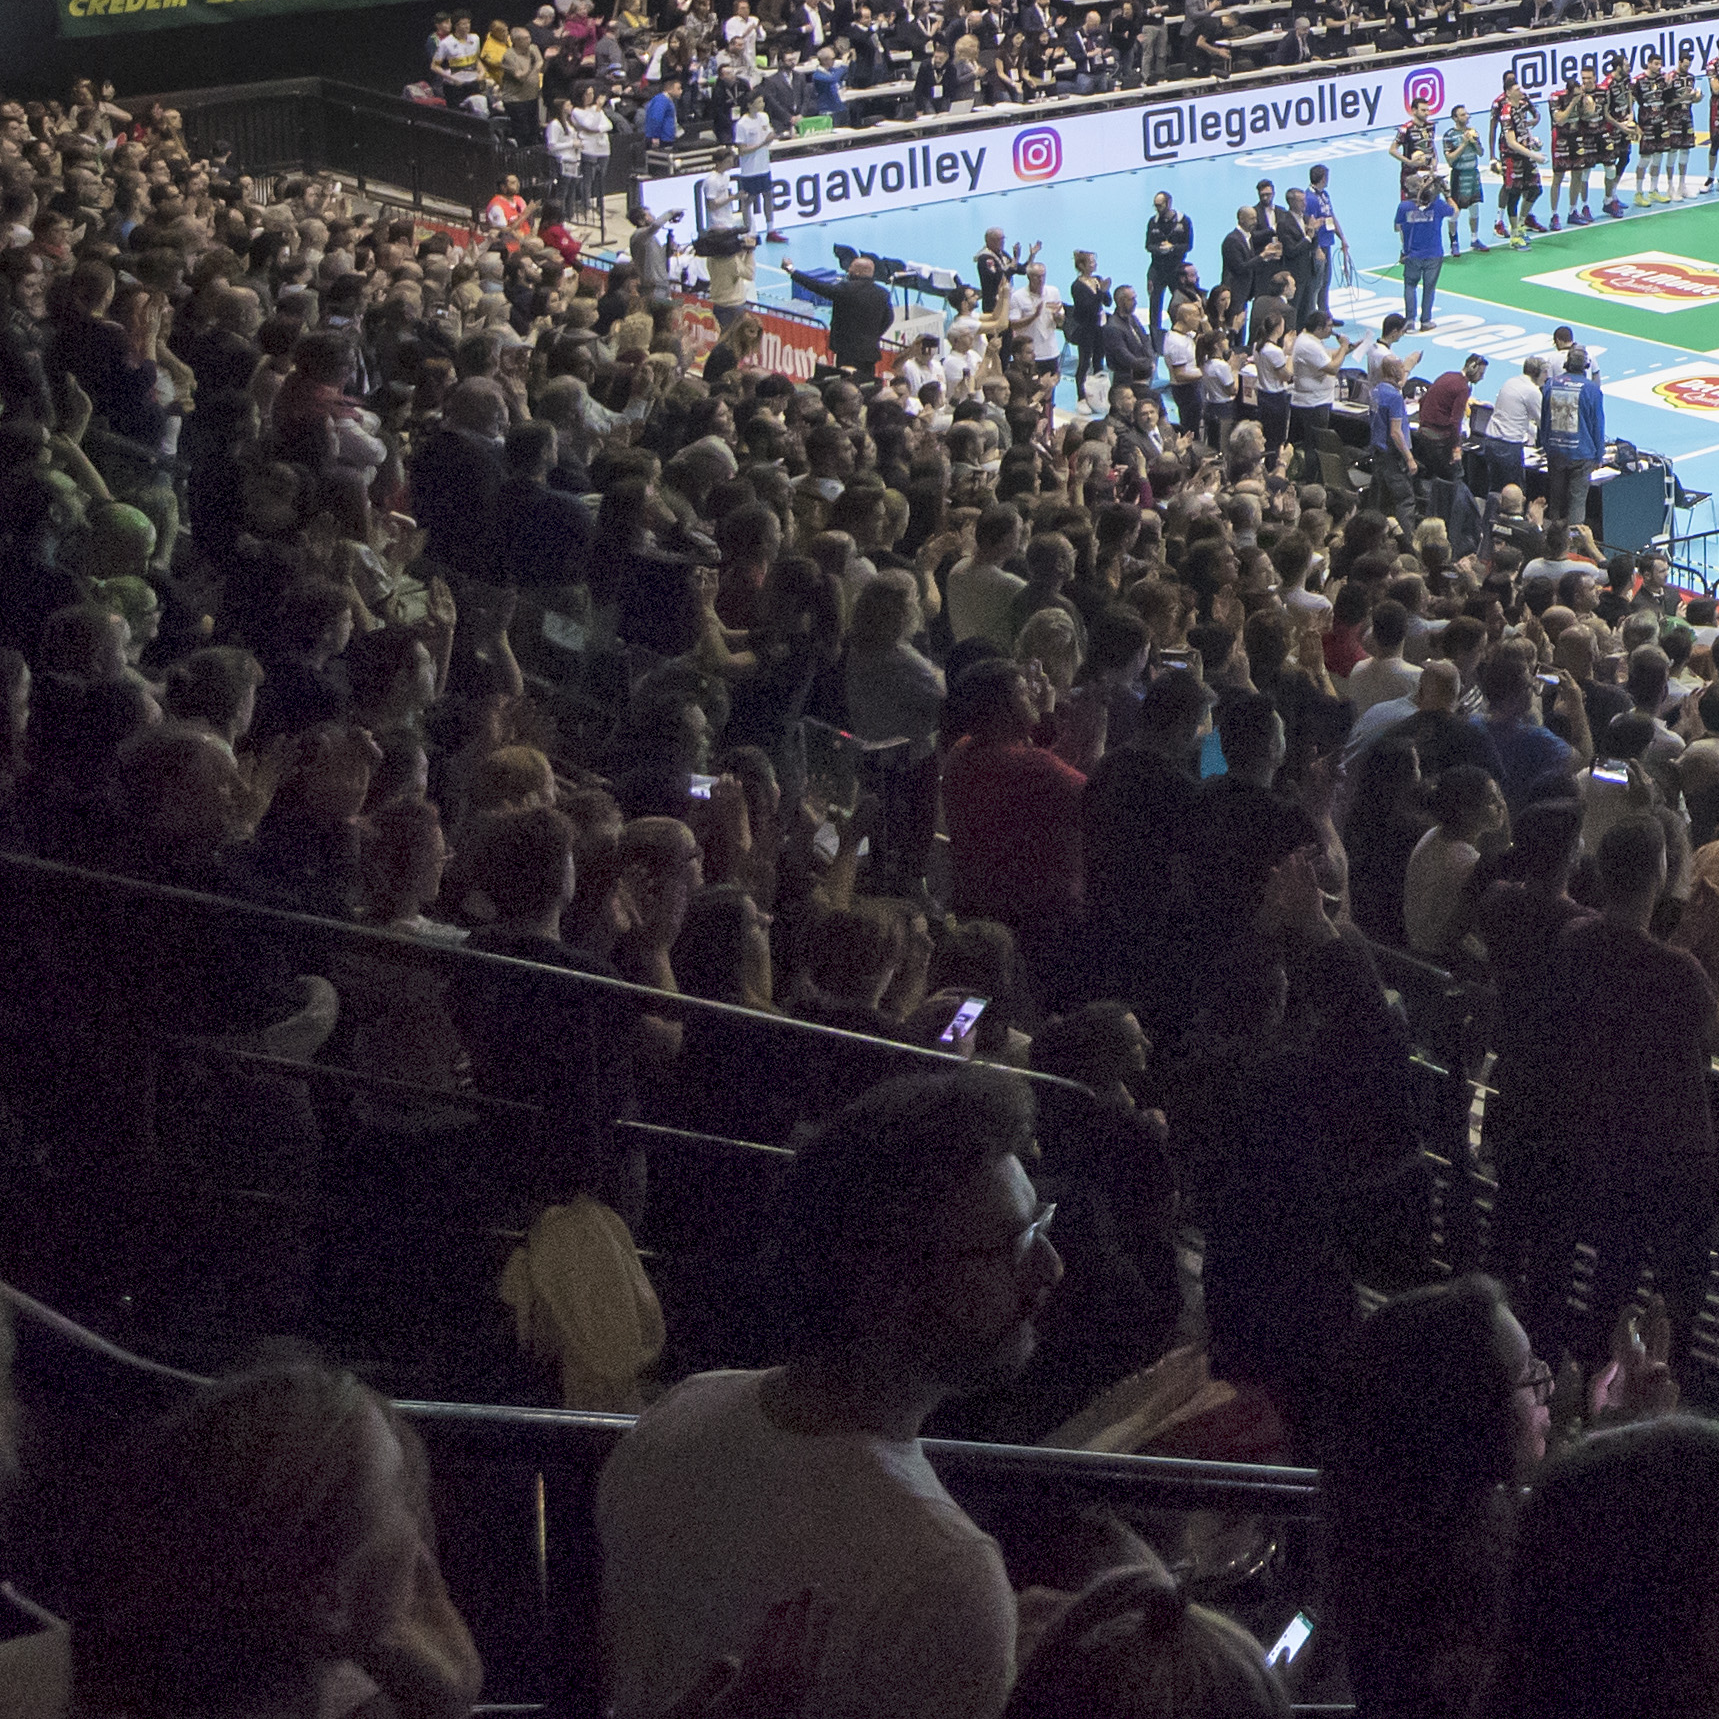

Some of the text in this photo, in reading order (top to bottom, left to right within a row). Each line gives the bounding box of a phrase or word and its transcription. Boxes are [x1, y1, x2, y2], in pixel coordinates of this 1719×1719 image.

[1143, 84, 1383, 161] @legavolley
[1603, 263, 1650, 284] Del
[1675, 378, 1714, 395] Del
